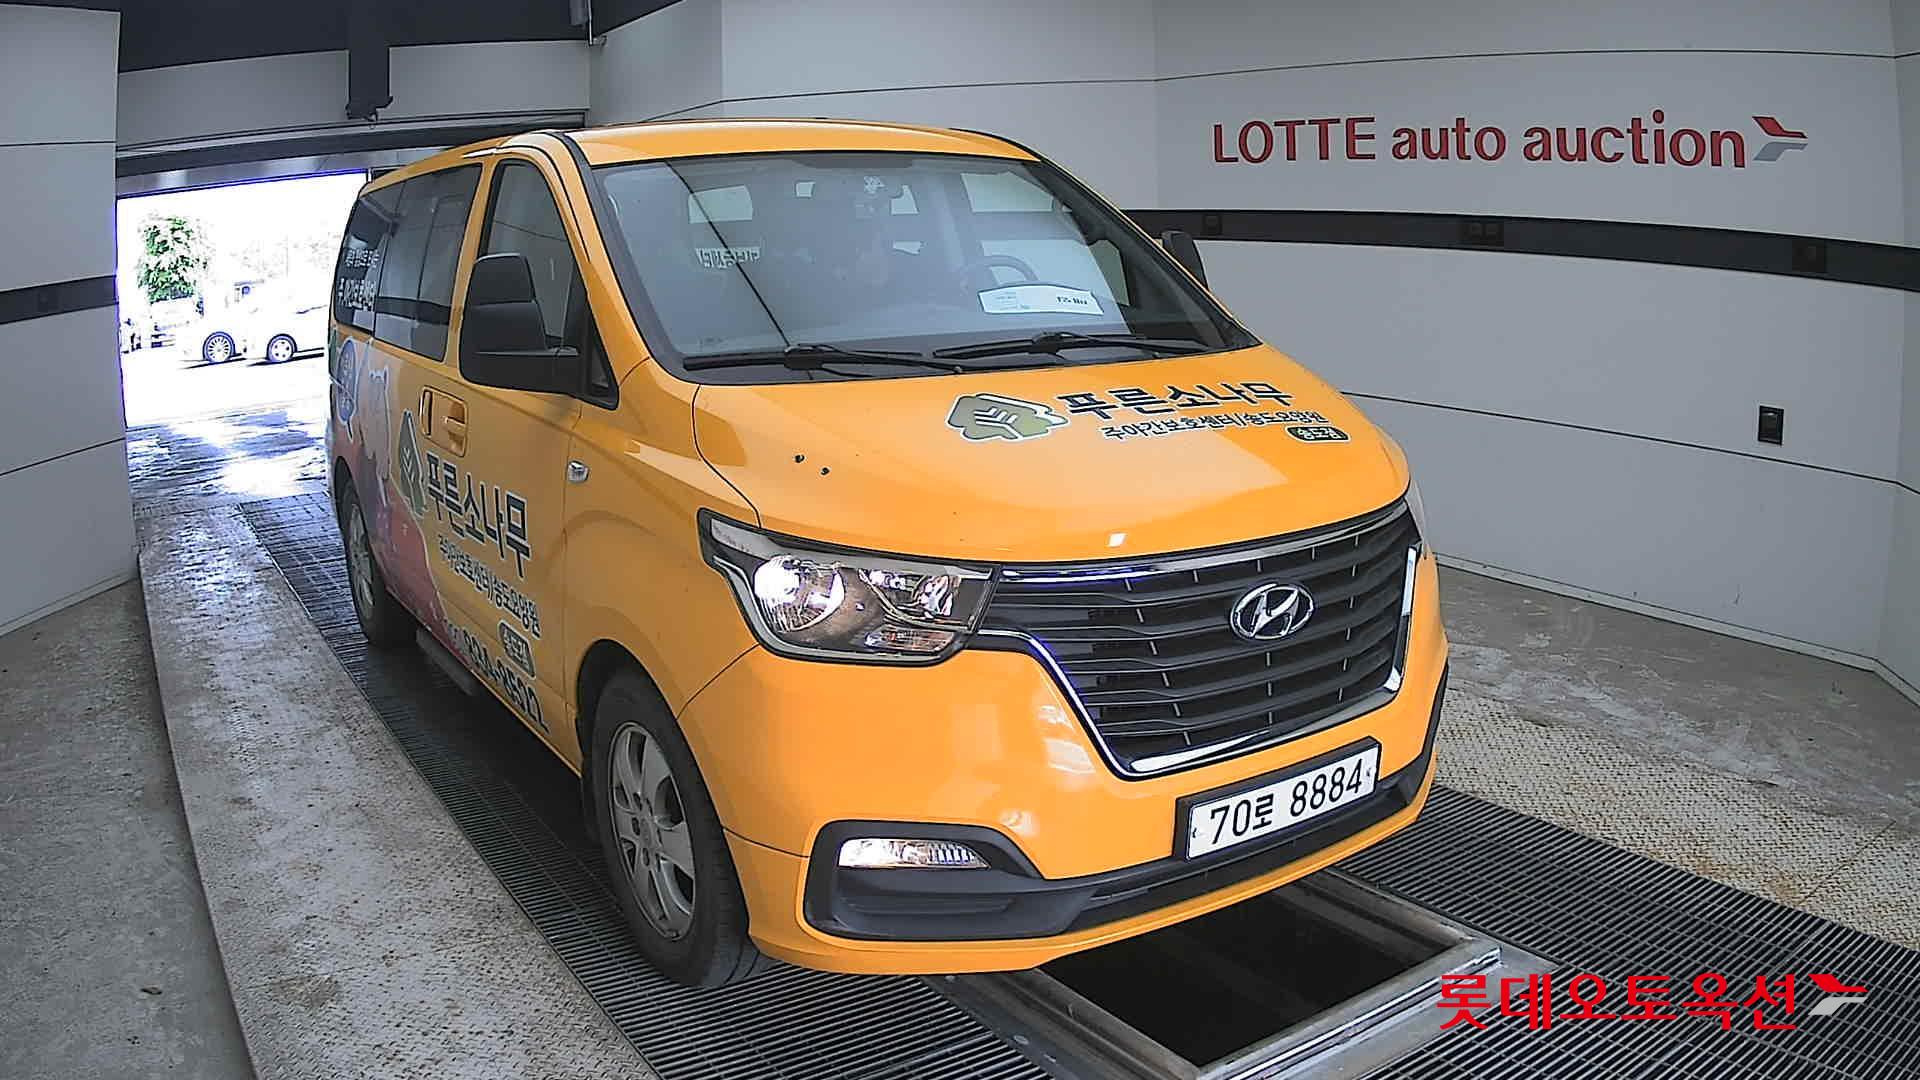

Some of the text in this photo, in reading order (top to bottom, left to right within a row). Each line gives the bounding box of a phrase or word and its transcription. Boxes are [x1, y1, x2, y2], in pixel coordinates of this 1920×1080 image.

[1213, 108, 1747, 169] LOTTE auto auction
[1056, 382, 1294, 420] 푸른소나무
[426, 453, 532, 580] 푸른소나무
[1209, 757, 1363, 845] 70로 8884
